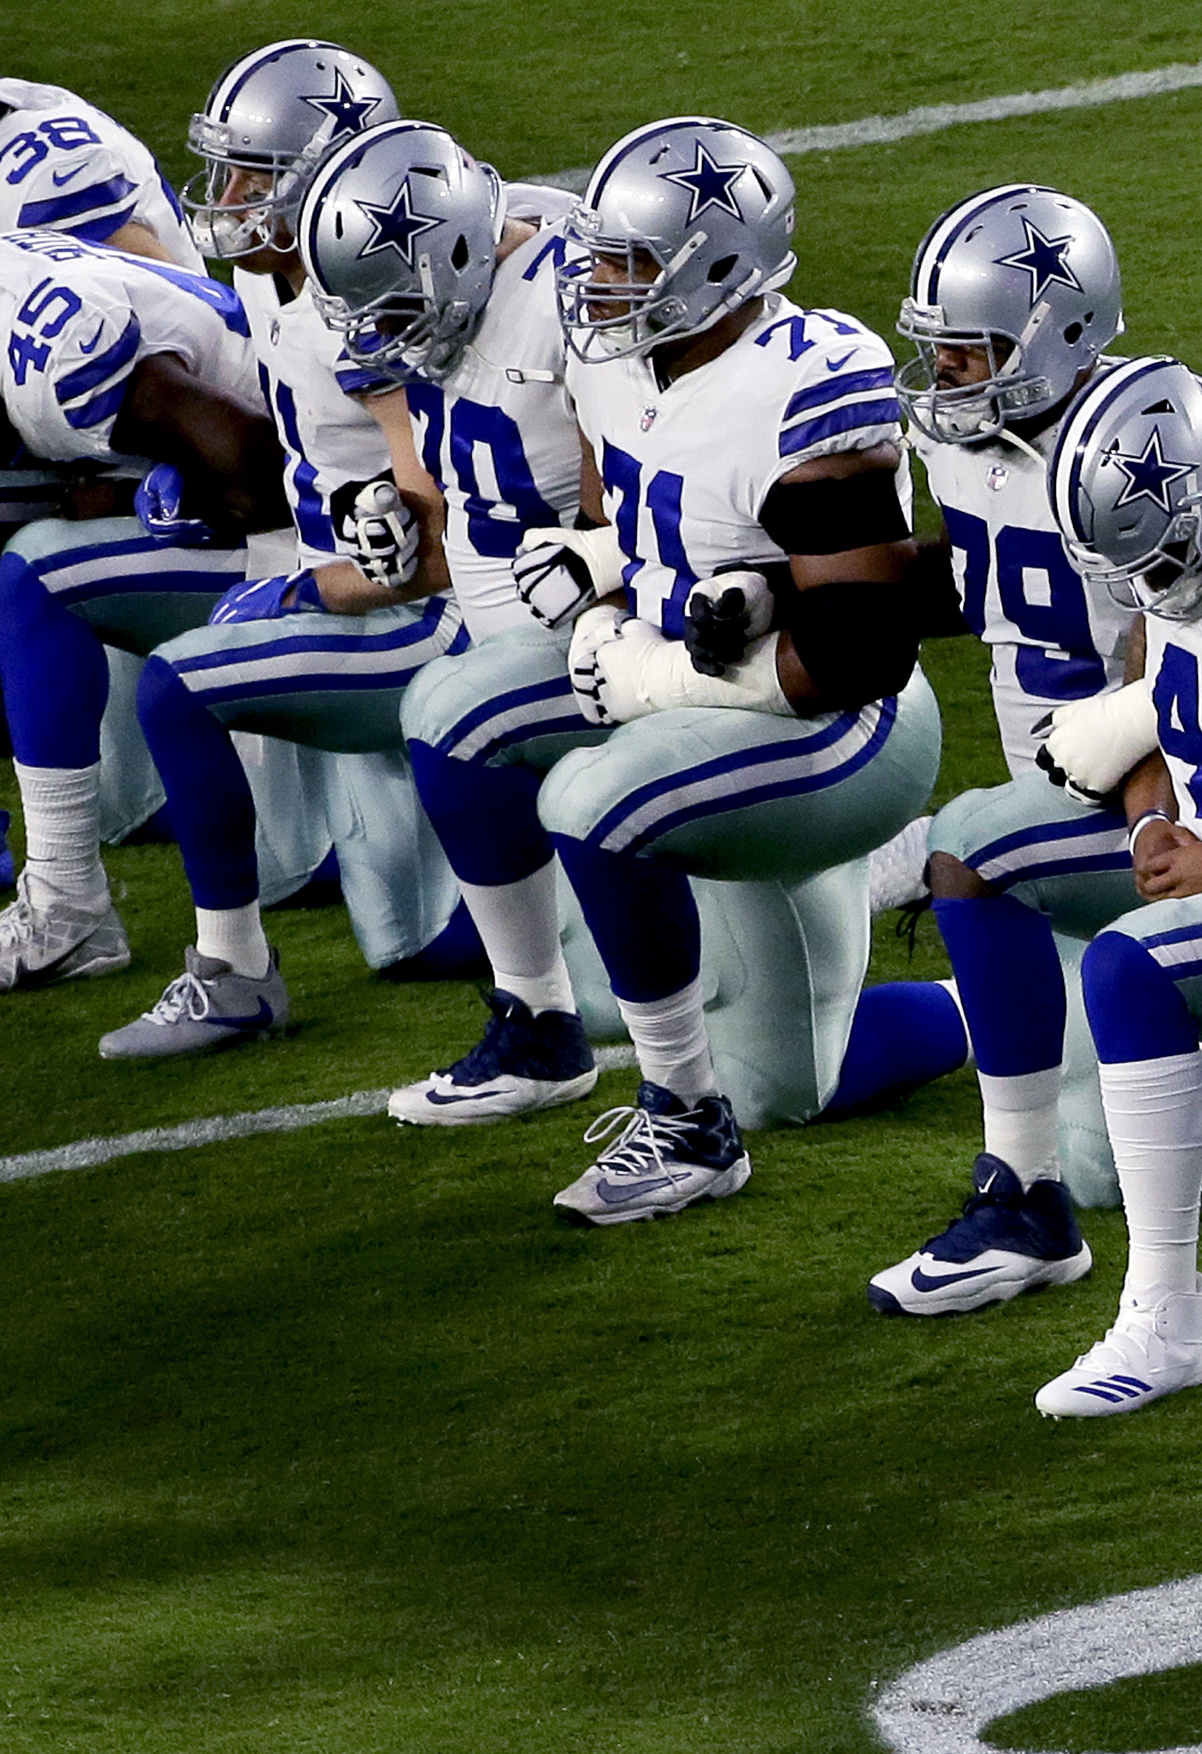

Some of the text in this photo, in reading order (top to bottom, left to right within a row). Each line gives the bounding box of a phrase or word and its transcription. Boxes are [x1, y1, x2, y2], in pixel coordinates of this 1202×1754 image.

[0, 117, 103, 184] 38
[8, 277, 82, 385] 45
[755, 310, 862, 361] 71
[257, 358, 337, 553] 1
[404, 383, 561, 558] 70
[602, 436, 702, 640] 71
[942, 504, 1108, 700] 79
